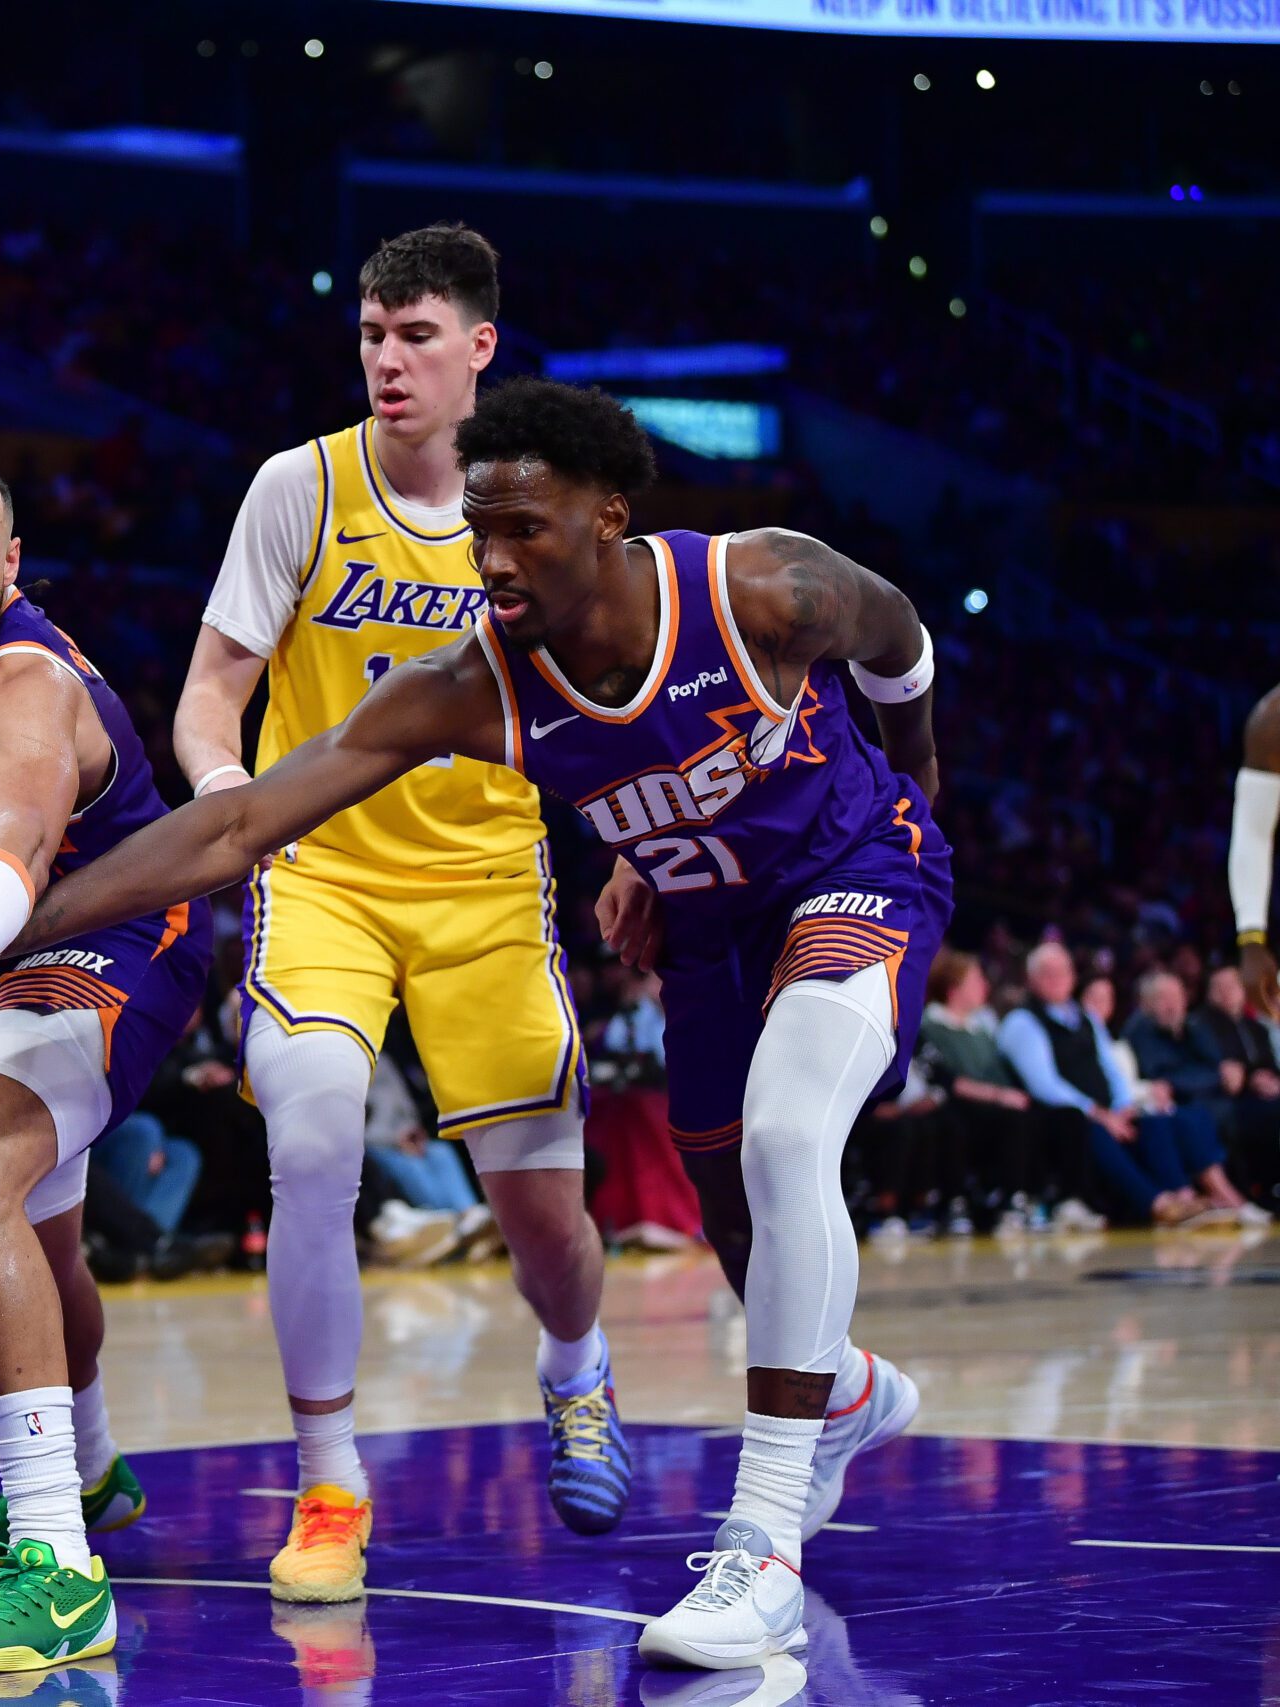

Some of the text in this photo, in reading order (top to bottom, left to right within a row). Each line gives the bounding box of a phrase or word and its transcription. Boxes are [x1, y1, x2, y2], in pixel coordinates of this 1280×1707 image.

[312, 560, 489, 632] LAKER
[668, 666, 729, 702] PayPal
[581, 750, 746, 844] UNS
[634, 836, 748, 893] 21
[13, 949, 115, 975] HOENIX
